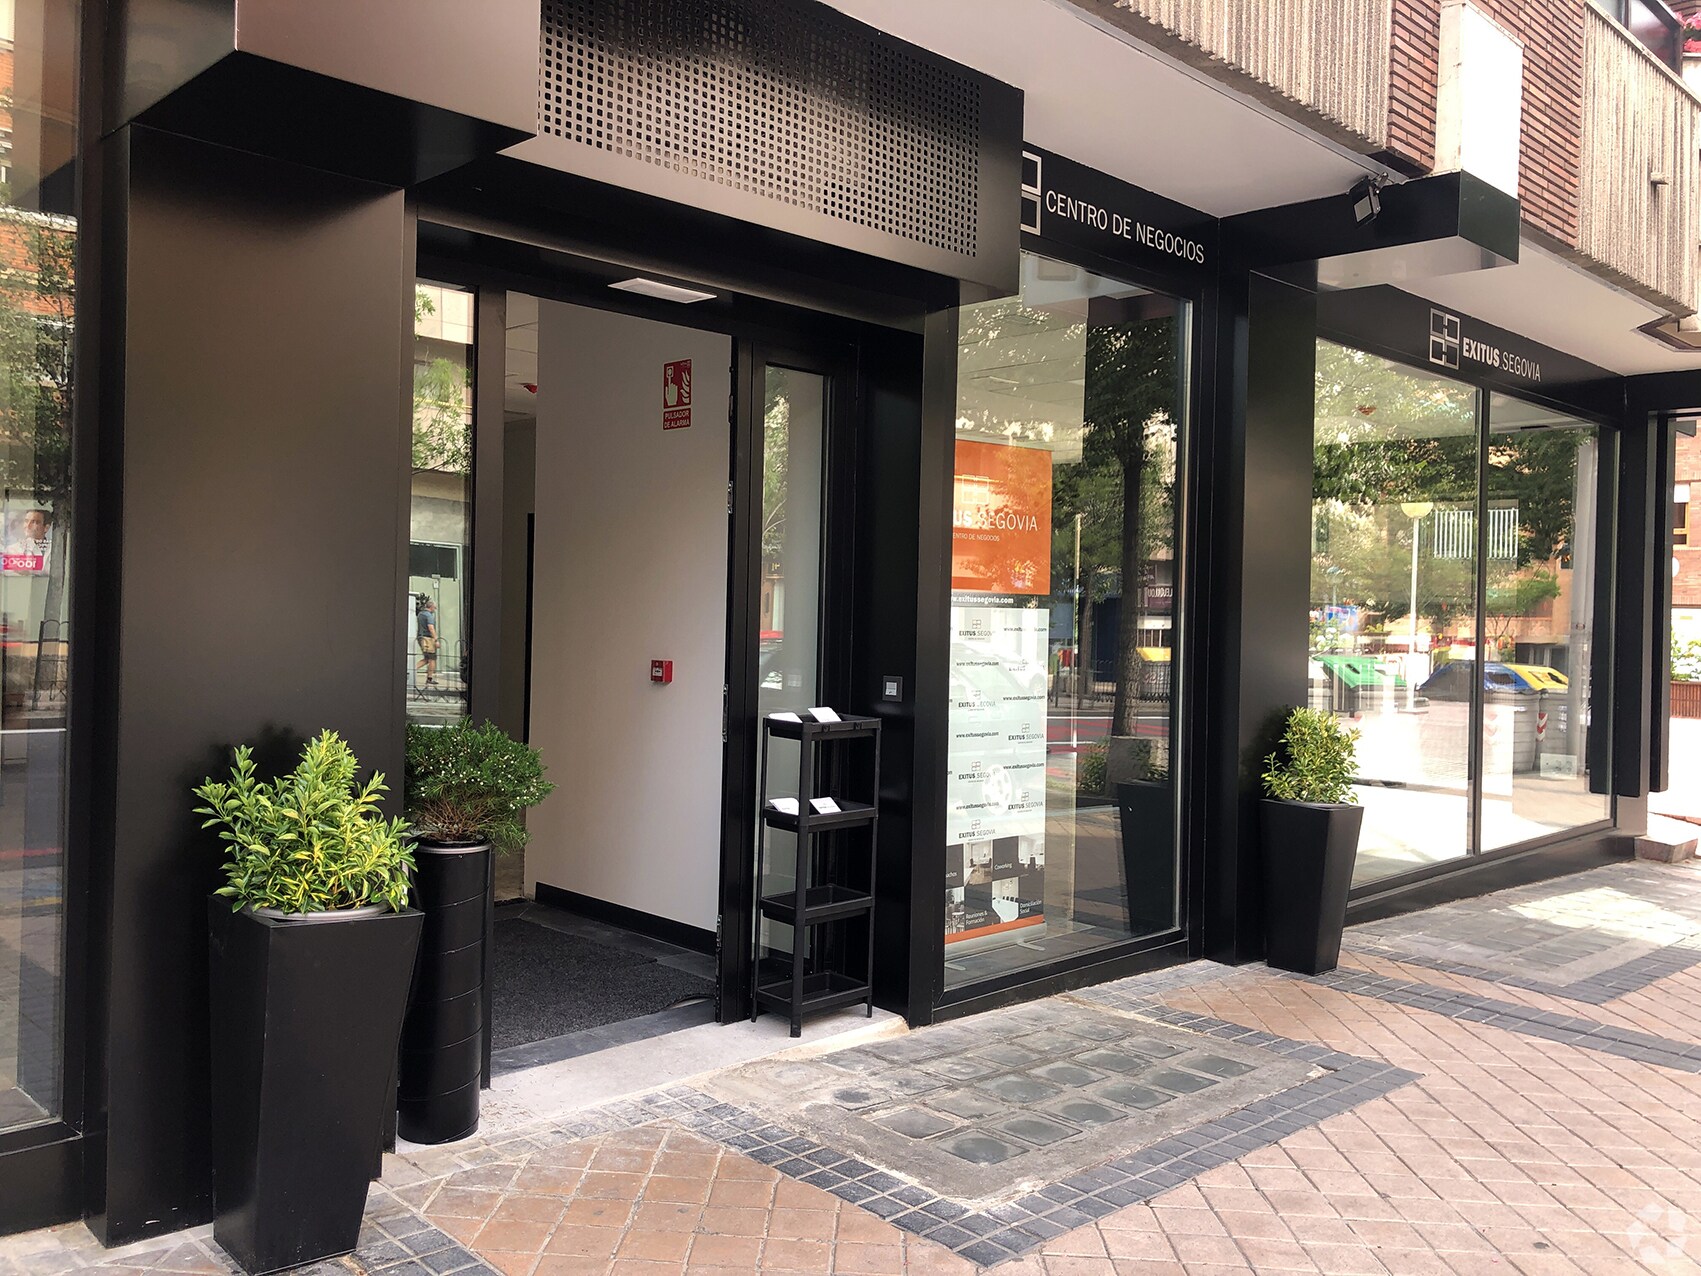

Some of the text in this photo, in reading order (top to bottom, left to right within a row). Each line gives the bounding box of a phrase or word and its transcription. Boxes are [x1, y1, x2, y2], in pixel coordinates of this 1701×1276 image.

[1045, 190, 1205, 264] CENTRO DE NEGOCIOS
[1462, 337, 1541, 382] EXITUS SEGOVIA
[665, 410, 689, 420] PULSADOR
[671, 419, 690, 427] ALARMA
[953, 510, 1038, 532] US SEGOVIA
[953, 532, 968, 540] ENTRO
[968, 533, 976, 541] DE
[951, 595, 1014, 605] w.exitussegovia.com
